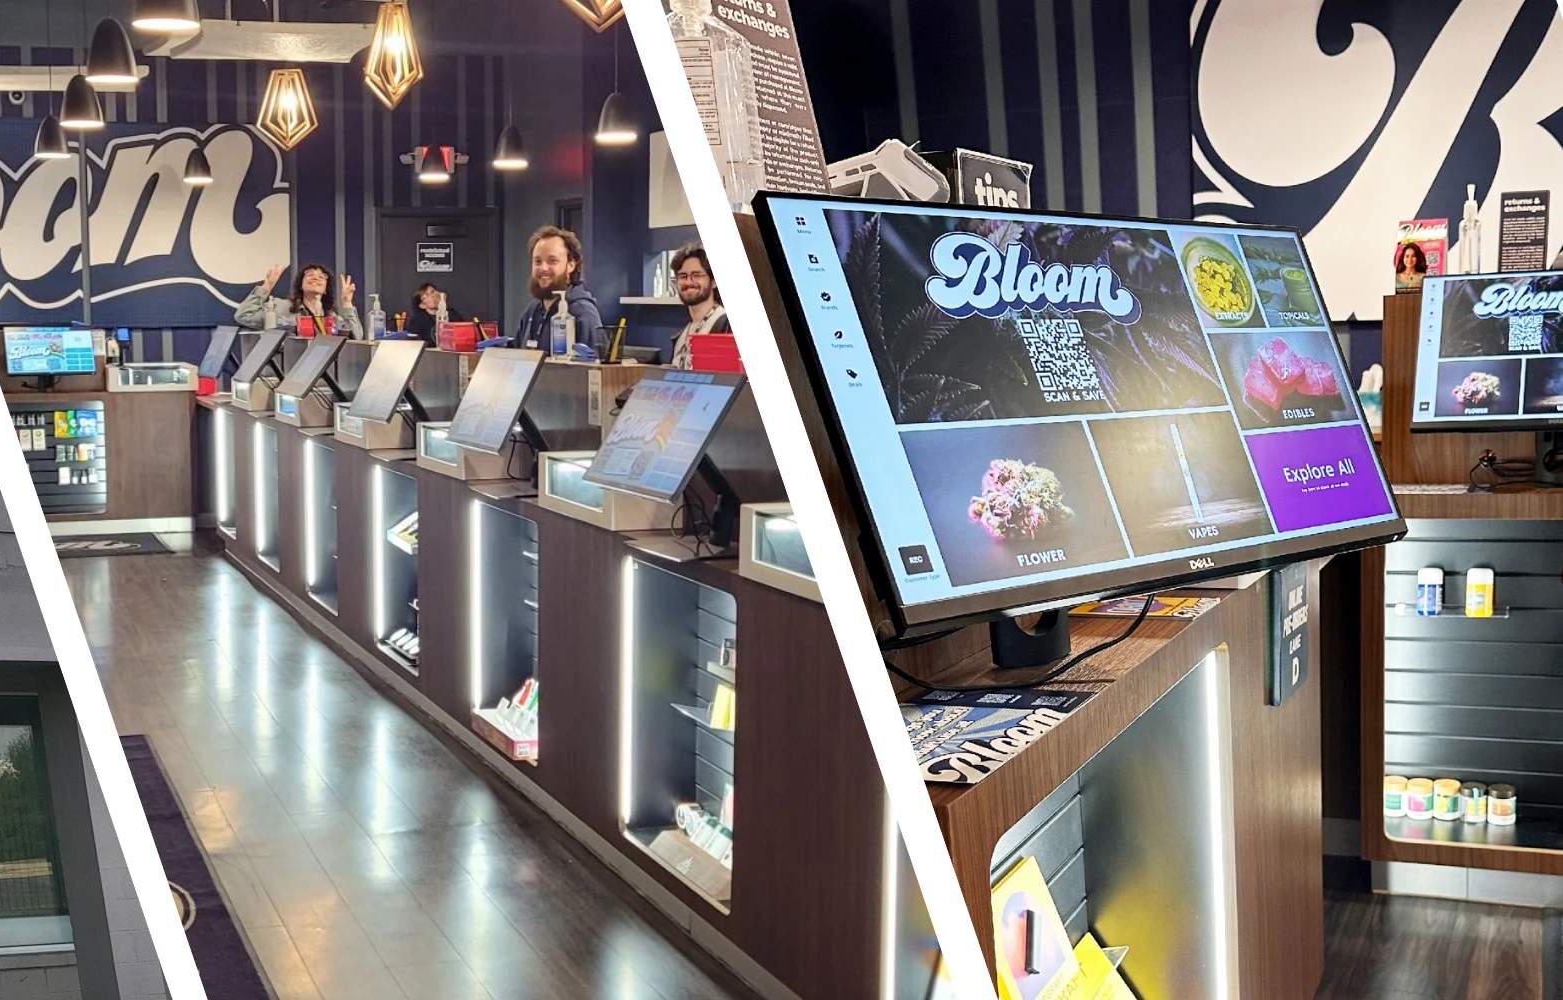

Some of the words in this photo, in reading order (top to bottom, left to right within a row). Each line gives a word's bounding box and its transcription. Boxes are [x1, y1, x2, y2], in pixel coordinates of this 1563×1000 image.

[724, 0, 764, 14] urns
[766, 3, 776, 18] &
[718, 5, 790, 39] exchanges
[974, 172, 1020, 208] tips
[1503, 205, 1546, 213] exchanges
[926, 232, 1139, 320] Bloom
[1278, 312, 1310, 320] TOPICALS
[1043, 391, 1071, 403] SCAN
[1082, 390, 1107, 401] SAVE
[1282, 408, 1315, 419] EDIBLES
[1283, 463, 1335, 484] Explore
[1338, 458, 1355, 475] All
[1188, 525, 1220, 540] VAPES
[1016, 549, 1067, 567] FLOWER
[1188, 557, 1215, 570] DELL
[1292, 656, 1300, 686] D
